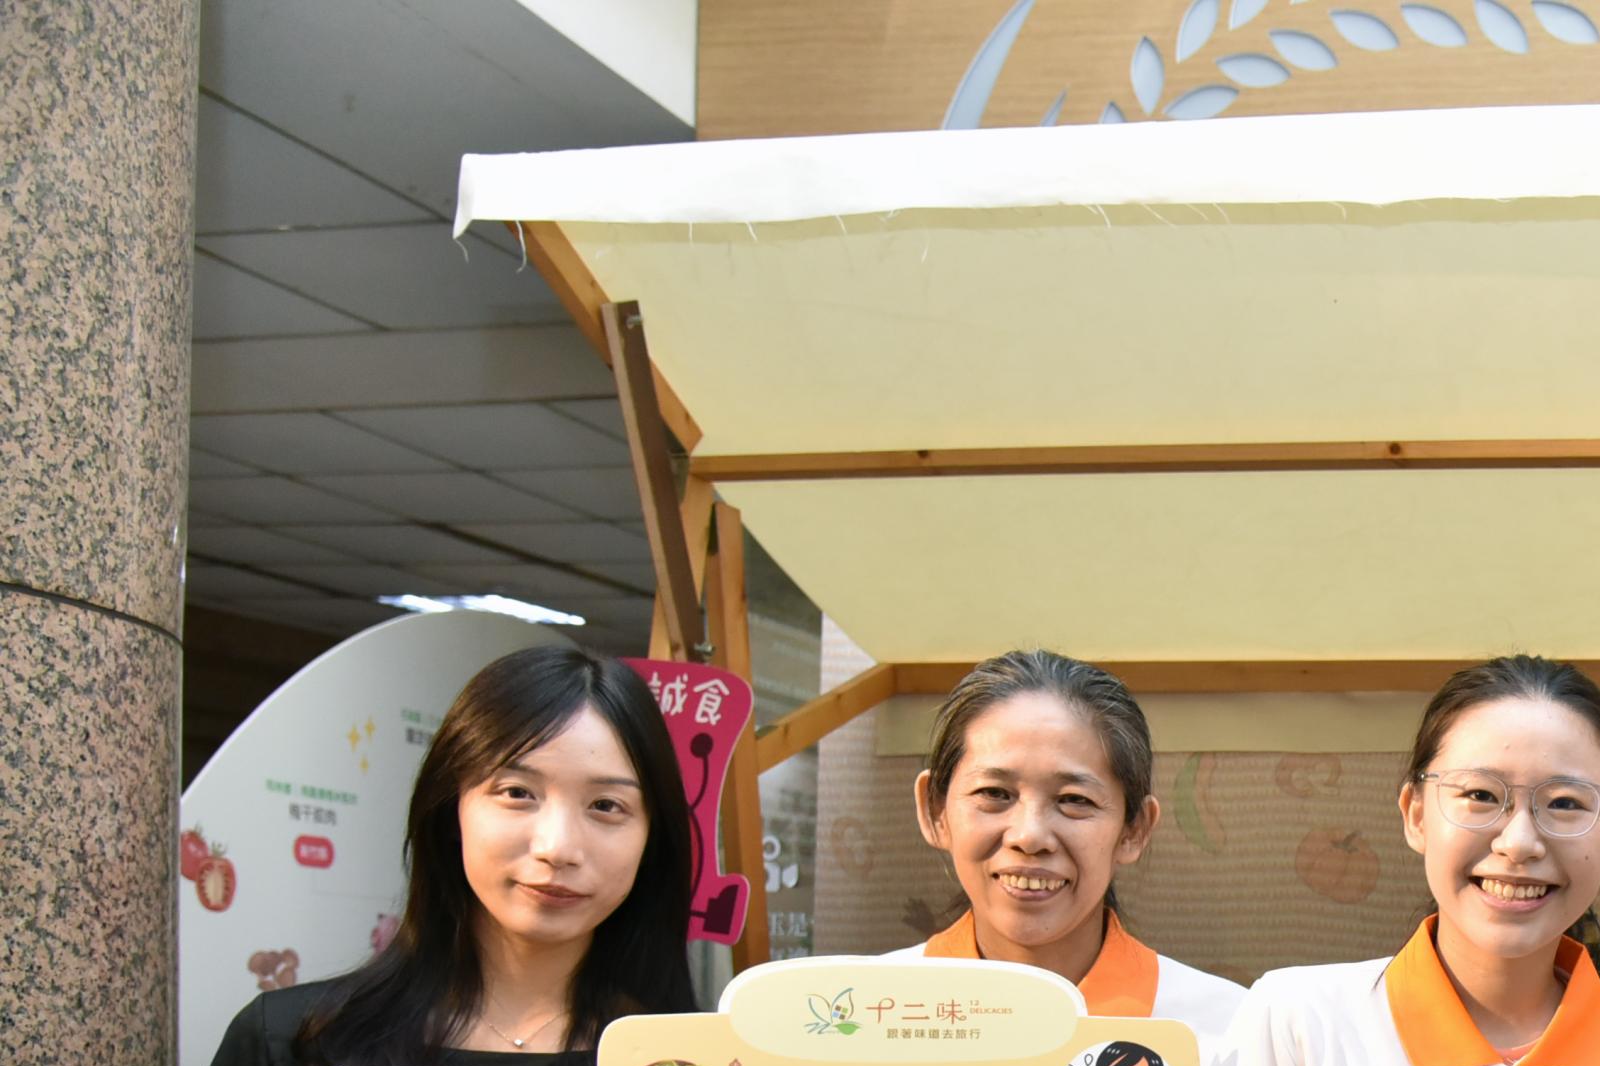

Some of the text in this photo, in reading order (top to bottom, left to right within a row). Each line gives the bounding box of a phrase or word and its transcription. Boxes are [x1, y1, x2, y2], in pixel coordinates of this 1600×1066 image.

[866, 997, 967, 1025] 十二味
[886, 1028, 981, 1039] 跟著味道去旅行
